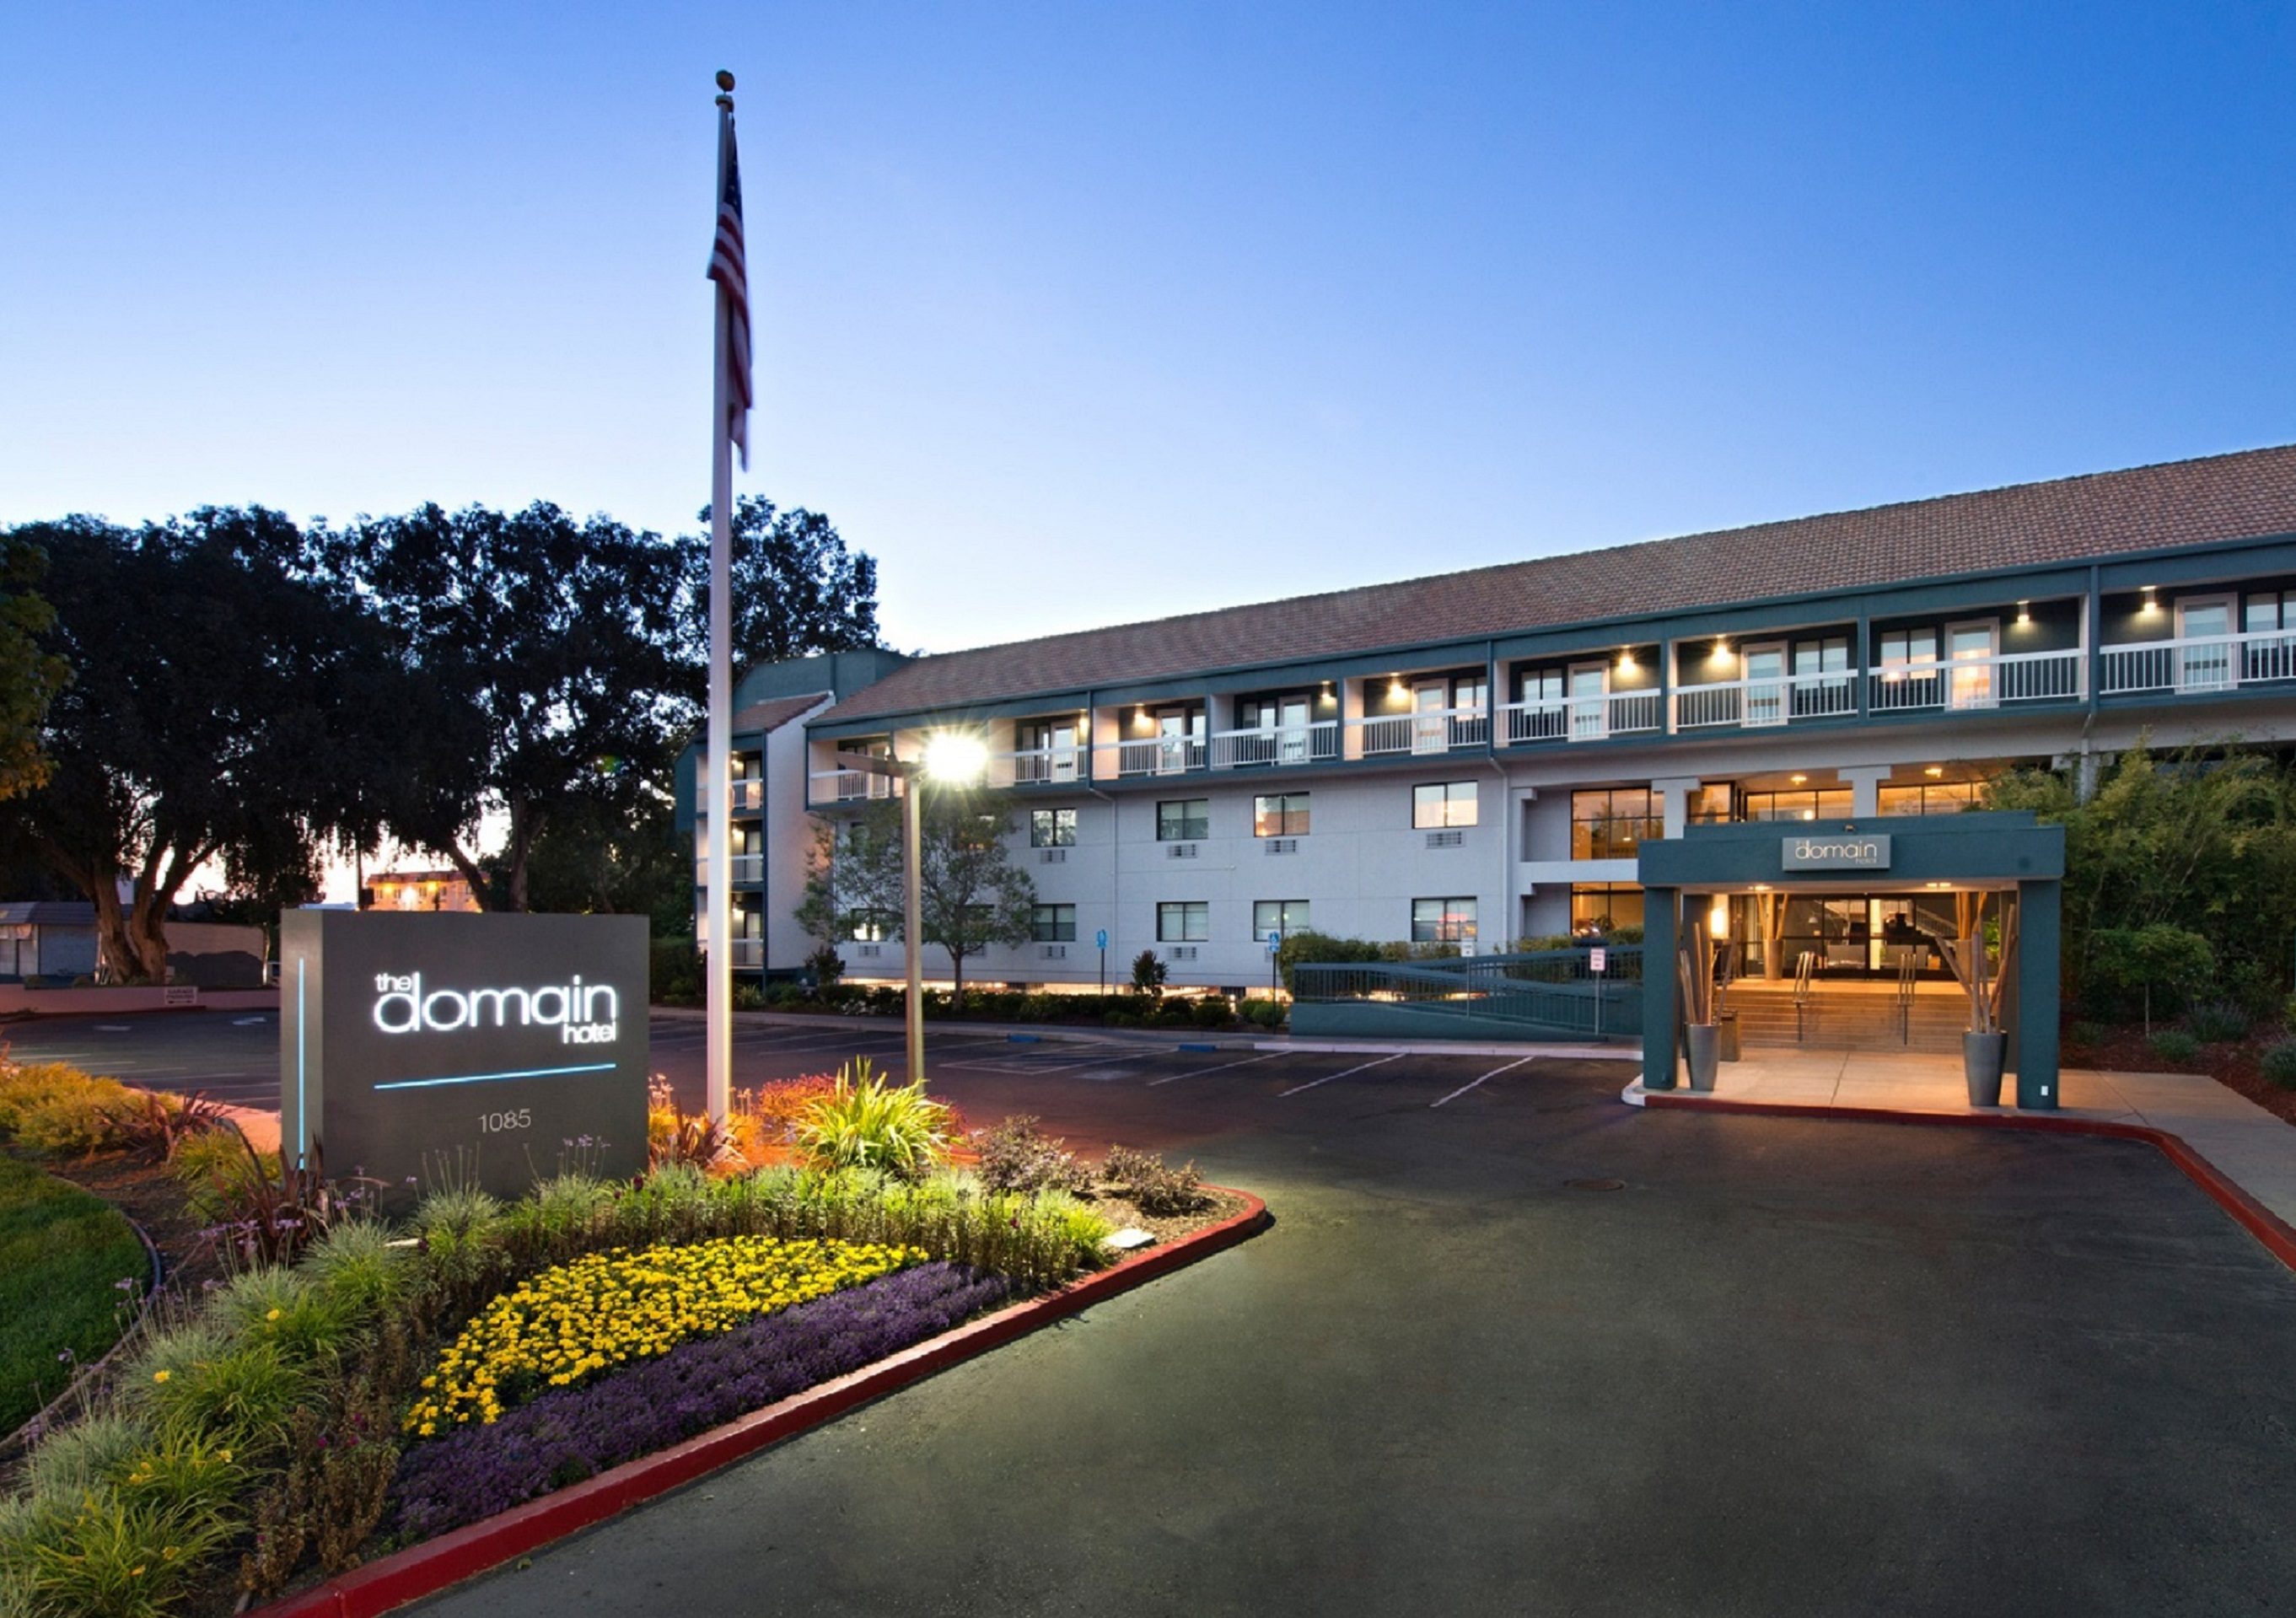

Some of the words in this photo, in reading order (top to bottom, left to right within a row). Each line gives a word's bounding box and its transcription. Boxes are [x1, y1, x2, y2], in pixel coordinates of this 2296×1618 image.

[1795, 840, 1877, 858] domain
[374, 974, 412, 992] the
[374, 971, 617, 1033] domain
[562, 1023, 616, 1044] hotel
[478, 1109, 532, 1133] 1085
